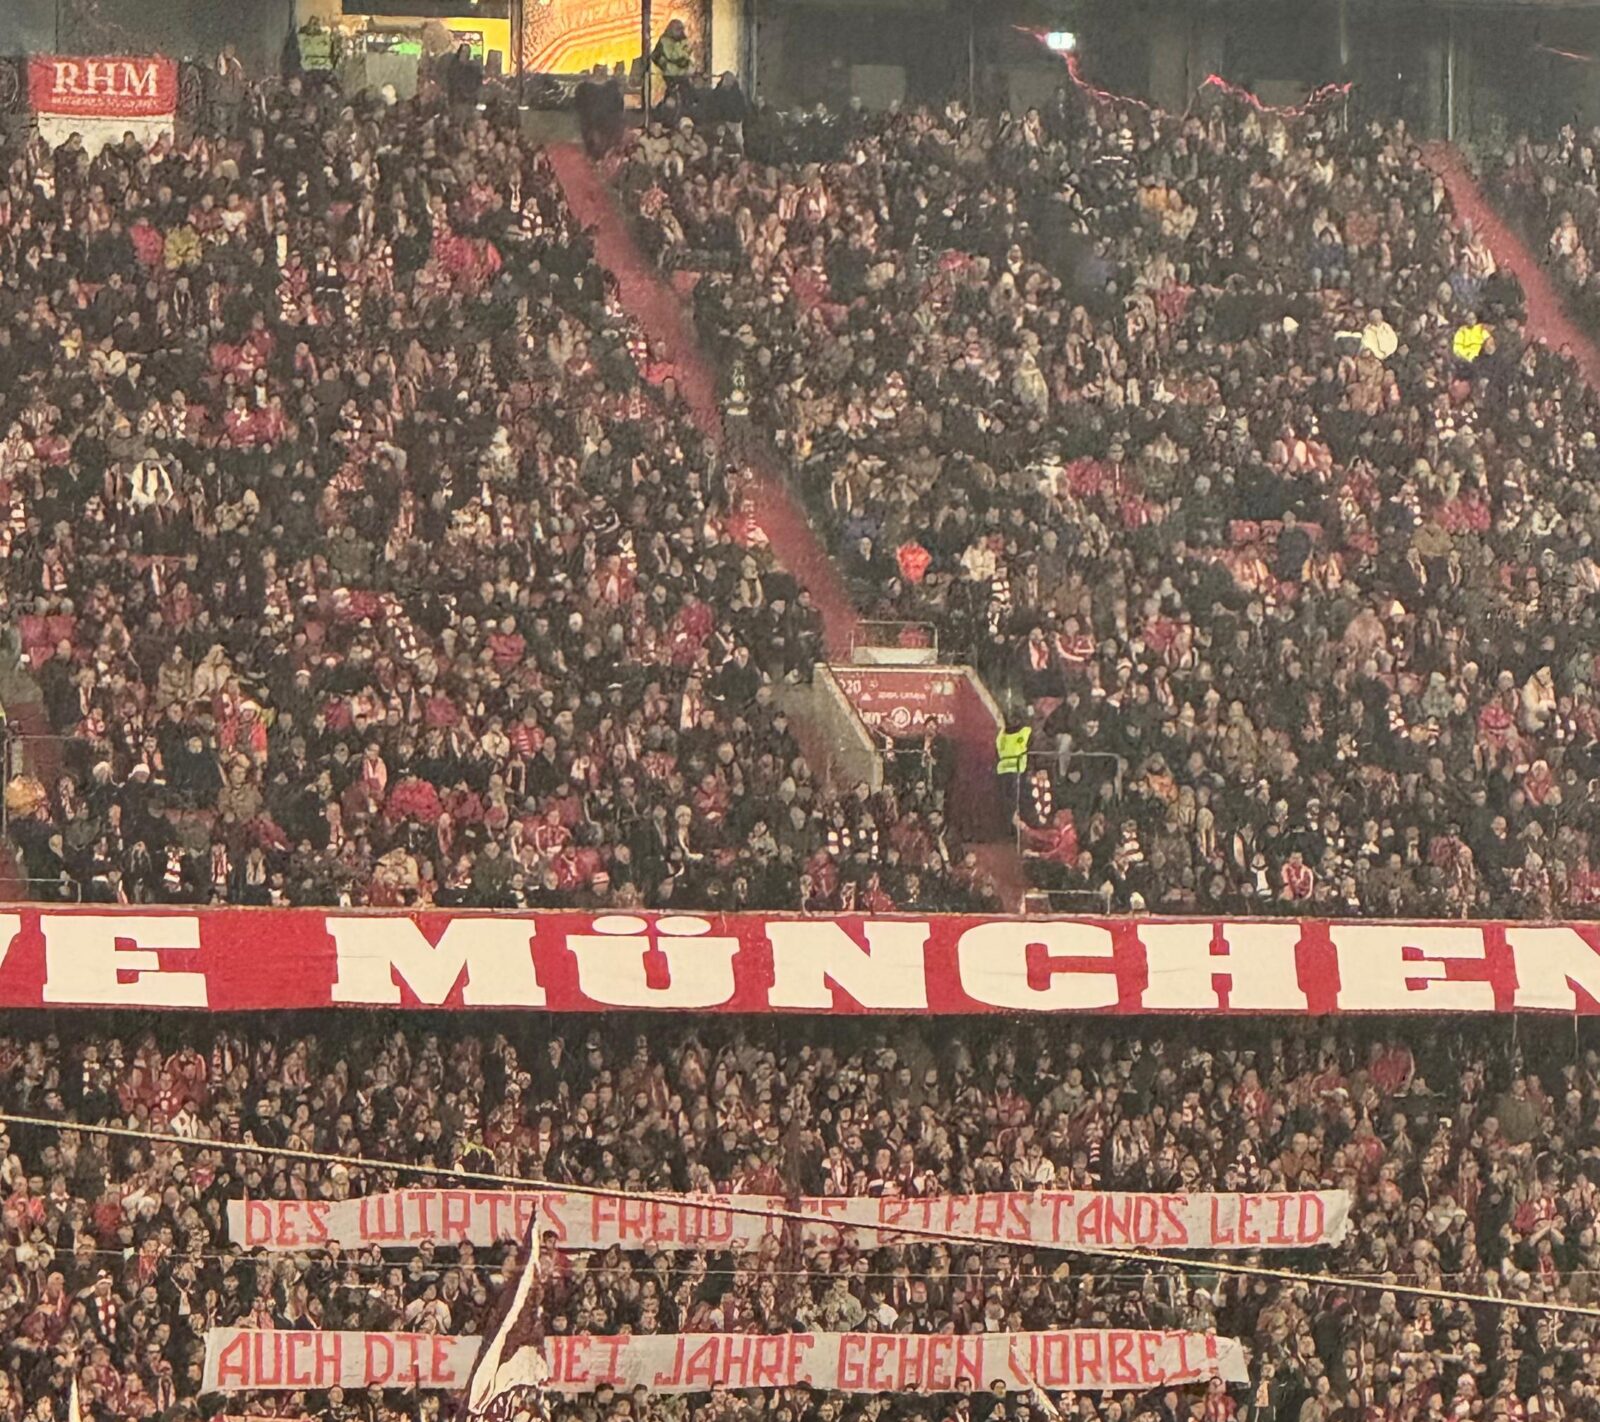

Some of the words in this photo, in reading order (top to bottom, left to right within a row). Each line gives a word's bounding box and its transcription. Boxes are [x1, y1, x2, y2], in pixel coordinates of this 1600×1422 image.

[52, 62, 159, 97] RHM
[245, 1200, 331, 1246] DES
[359, 1190, 567, 1243] WIRTES
[592, 1194, 733, 1243] FREUD
[1210, 1194, 1324, 1244] LEID
[217, 1332, 342, 1386] AUCH
[364, 1334, 457, 1385] DIE
[654, 1334, 815, 1386] JAHRE
[838, 1334, 984, 1390] GEHEN
[1008, 1330, 1219, 1386] VORBEI!
